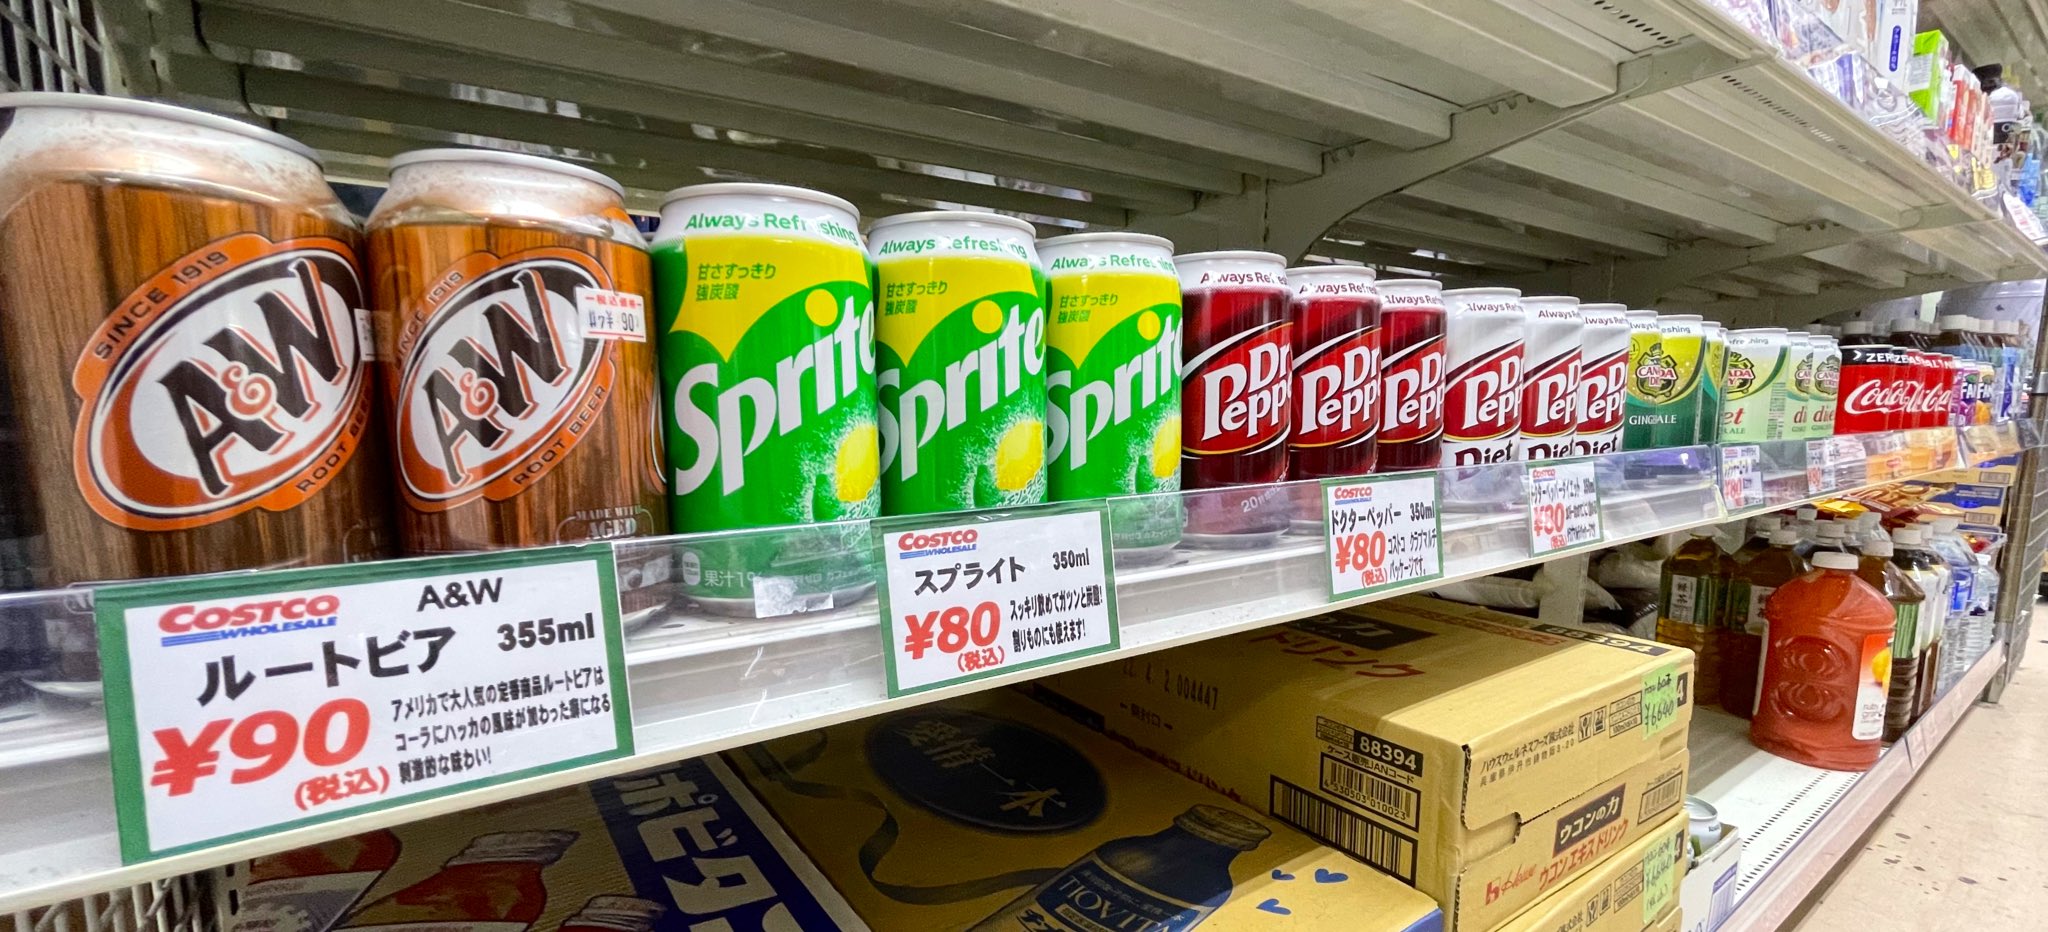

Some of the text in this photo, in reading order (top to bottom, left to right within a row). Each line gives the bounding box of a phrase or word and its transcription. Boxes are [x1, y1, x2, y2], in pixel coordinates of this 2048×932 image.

[763, 212, 859, 246] Refrshing
[879, 236, 936, 256] Always
[427, 271, 464, 305] 1919
[696, 283, 740, 302] 強炭酸
[697, 263, 777, 281] 甘さすっきり
[885, 281, 948, 297] 甘さすっきり
[95, 250, 228, 360] SINCE 1919
[884, 299, 918, 316] 強炭酸
[1058, 294, 1119, 309] 甘さすっきり
[156, 256, 348, 497] A&W
[422, 268, 573, 487] A&W
[674, 295, 876, 497] Sprite
[877, 303, 1045, 482] Sprite
[1201, 363, 1292, 442] Pepp
[1299, 364, 1381, 436] Pepp
[1382, 368, 1445, 433] Pepp
[1462, 370, 1523, 430] Pepp
[513, 385, 606, 484] ROOT BEER
[298, 441, 347, 492] ROOT
[1334, 486, 1373, 500] COSTCO
[1409, 500, 1435, 522] 350ml
[898, 529, 978, 551] COSTCO
[1335, 530, 1386, 574] ¥80
[914, 548, 1090, 596] スプライト 350ml
[159, 594, 340, 634] COSTCO
[416, 577, 503, 612] A&W
[219, 616, 338, 641] WHOLESALE
[904, 601, 1001, 660] ¥80
[1545, 626, 1654, 653] 88394
[197, 613, 595, 707] ルートビア 355ml
[957, 646, 1005, 673] (税込)
[391, 665, 605, 722] アメリカで大人気の定番商品ルートビアは
[151, 698, 371, 798] ¥90
[1359, 735, 1418, 771] 88394
[295, 766, 390, 811] (税込)
[1370, 797, 1407, 821] 010023
[1560, 796, 1620, 845] ウコンの力
